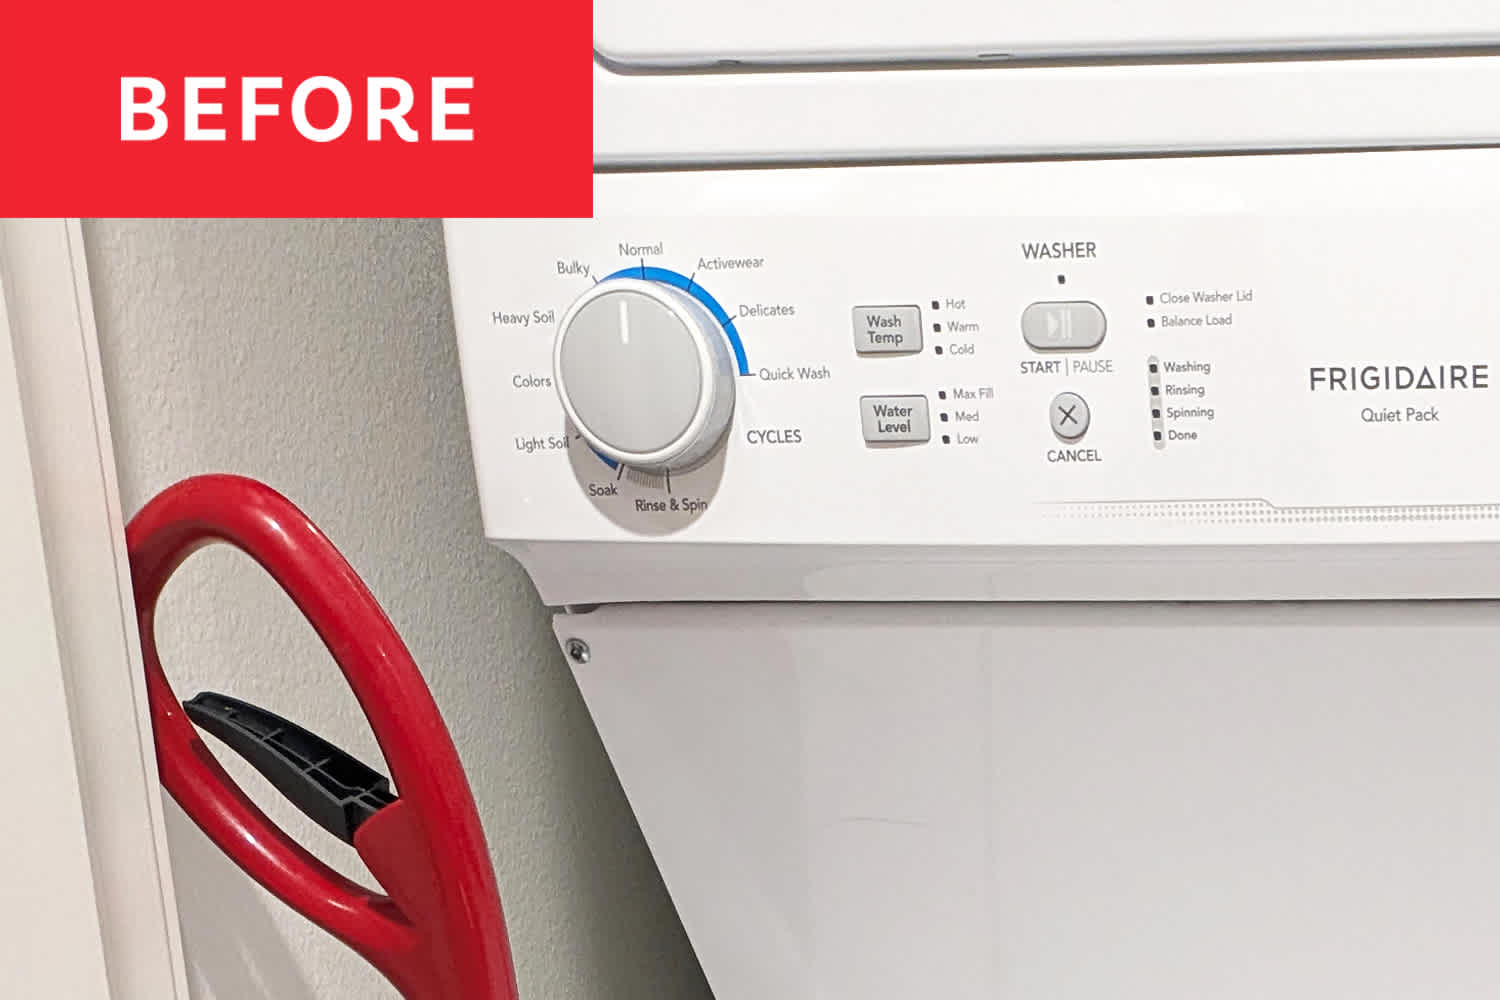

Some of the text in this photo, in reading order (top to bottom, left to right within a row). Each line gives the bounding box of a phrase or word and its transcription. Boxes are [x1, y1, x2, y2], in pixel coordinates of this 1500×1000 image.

[618, 241, 664, 257] Normal
[1021, 241, 1097, 260] WASHER
[556, 260, 590, 278] Bulky
[697, 256, 765, 271] Activewear
[945, 298, 966, 310] Hot
[1159, 289, 1253, 305] Close Washer Lid
[492, 309, 556, 327] Heavy Soil
[738, 303, 796, 318] Delicates
[866, 314, 902, 328] Wash
[946, 319, 980, 333] Warm
[1161, 312, 1233, 328] Balance Load
[866, 330, 904, 348] Temp
[949, 343, 975, 356] Cold
[759, 365, 831, 381] Quick Wash
[1020, 359, 1113, 375] START PAUSE
[1163, 360, 1211, 376] Washing
[512, 373, 552, 389] Colors
[1309, 364, 1489, 392] FRIGIDAIRE
[952, 387, 995, 400] Max Fill
[1165, 383, 1206, 399] Rinsing
[872, 404, 913, 418] Water
[954, 410, 980, 422] Med
[1166, 406, 1215, 421] Spinning
[1360, 406, 1440, 423] Quiet Pack
[877, 418, 912, 434] Level
[746, 428, 803, 445] CYCLES
[956, 433, 979, 445] Low
[1167, 429, 1198, 441] Done
[514, 434, 571, 454] Light Soil
[1047, 448, 1103, 463] CANCEL
[588, 482, 619, 497] Soak
[634, 497, 708, 515] Rinse & Spin
